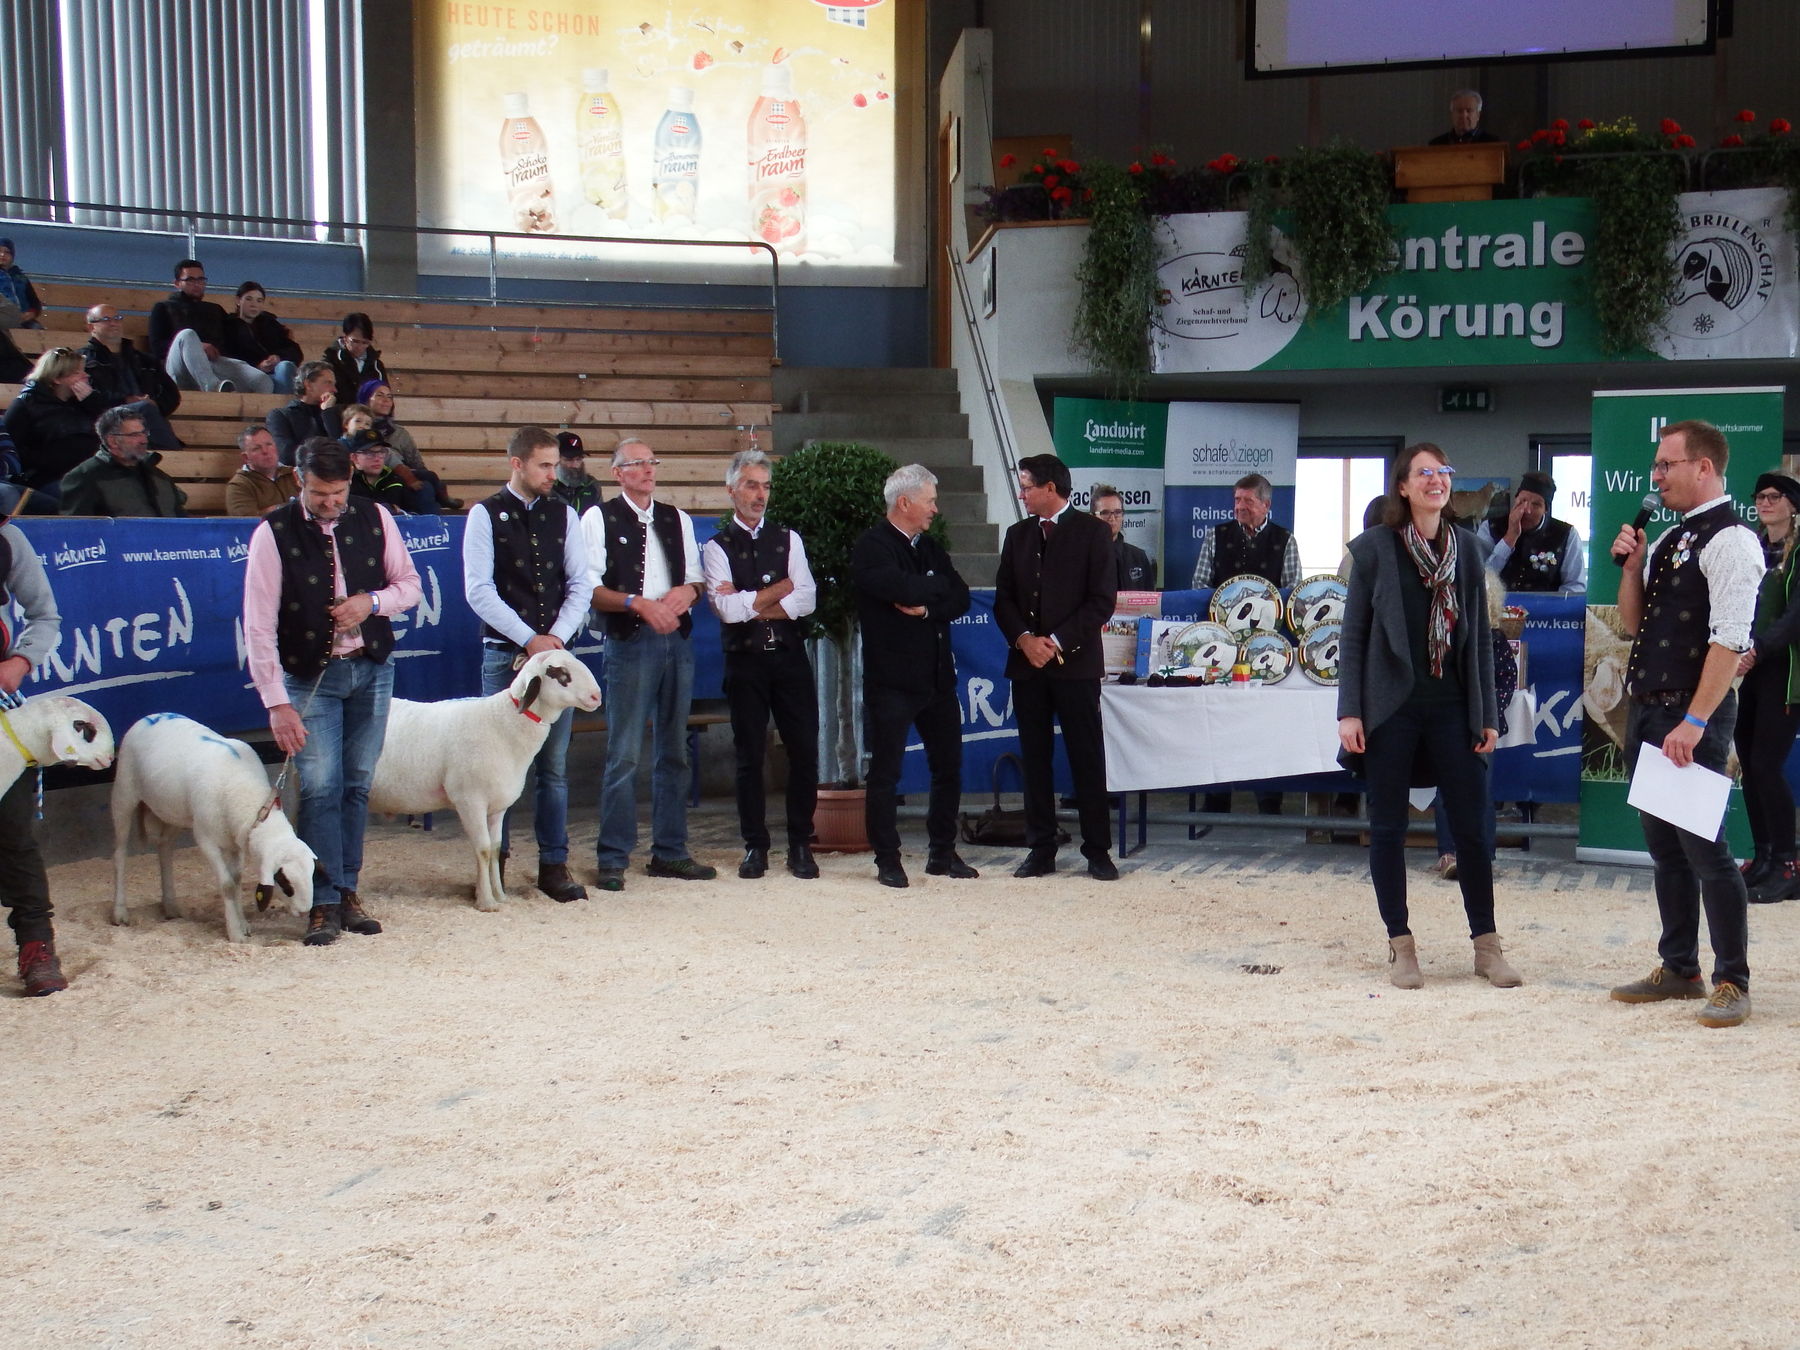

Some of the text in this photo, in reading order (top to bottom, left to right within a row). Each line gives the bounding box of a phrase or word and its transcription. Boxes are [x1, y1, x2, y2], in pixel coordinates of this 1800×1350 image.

[447, 3, 600, 36] HEUTE SCHON
[448, 34, 560, 64] geträumt?
[516, 154, 548, 171] Schoko
[767, 145, 808, 162] Erdbeer
[504, 164, 549, 188] Traum
[653, 157, 698, 177] Traum
[749, 157, 805, 182] Traum
[1388, 221, 1586, 271] ntrale
[1690, 214, 1773, 302] BRILLENSCHAF
[1176, 317, 1248, 326] Ziegenzuchtverband
[1192, 308, 1231, 316] Schaf- und
[1348, 295, 1563, 348] Körung
[1083, 418, 1147, 442] Landwirt
[1089, 446, 1145, 456] landwirt-media.com
[1605, 470, 1643, 492] Wir
[123, 548, 222, 563] www.kaernten.at
